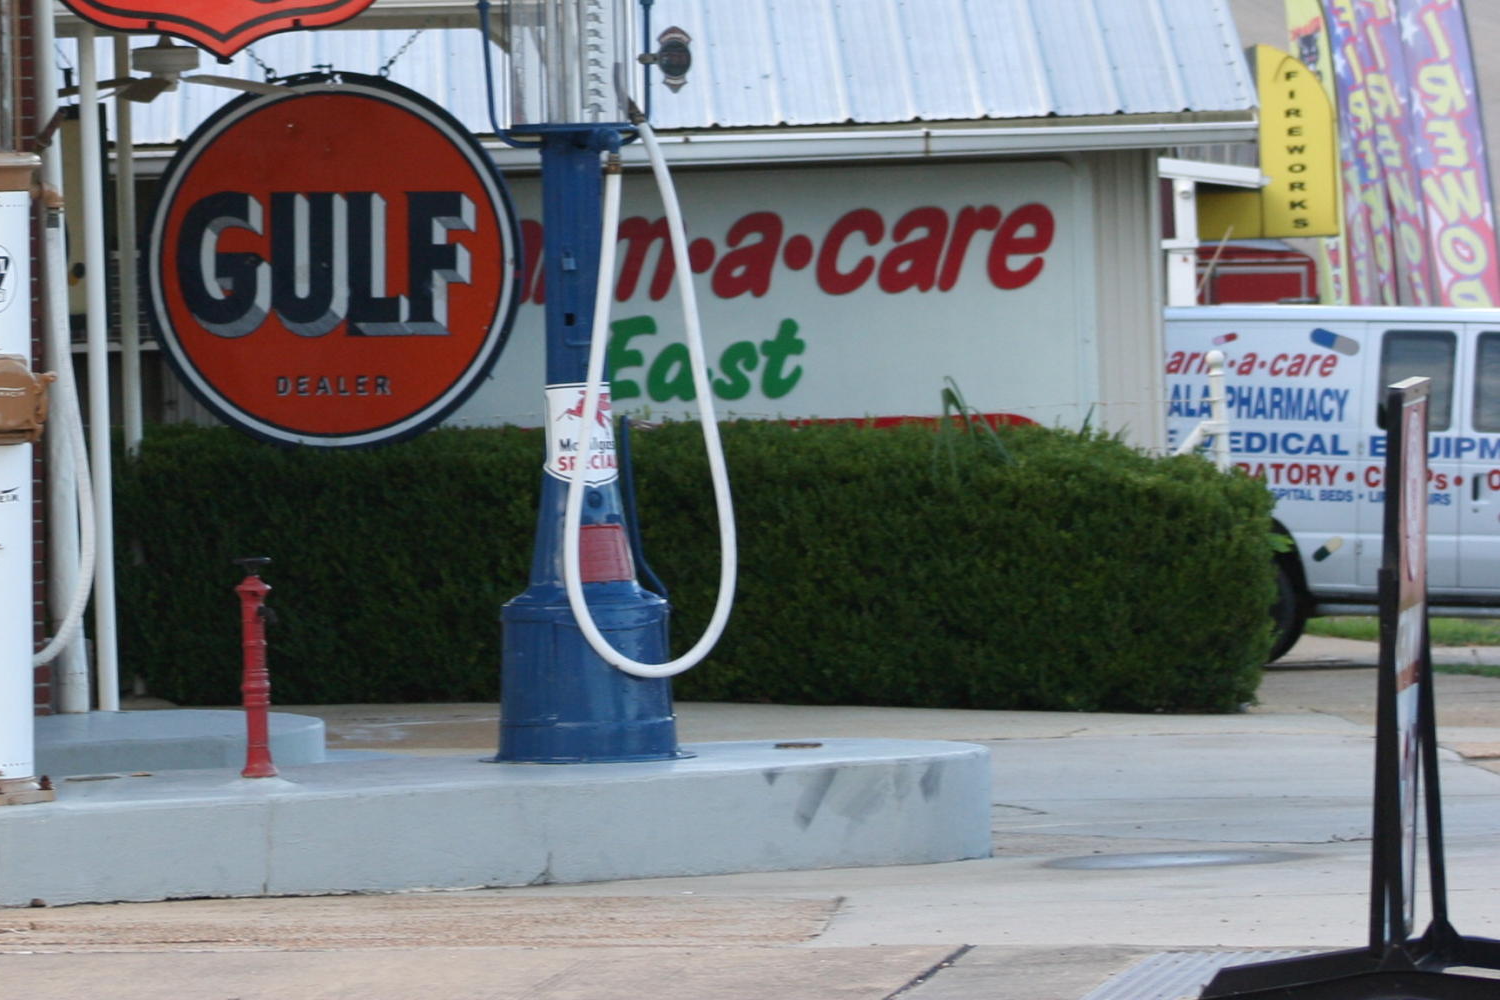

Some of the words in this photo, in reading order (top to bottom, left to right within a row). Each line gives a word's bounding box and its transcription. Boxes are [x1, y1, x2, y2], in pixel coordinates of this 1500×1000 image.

[1285, 71, 1309, 229] FIREWORKS
[177, 190, 476, 338] GULF
[608, 315, 805, 402] East
[276, 375, 391, 396] DEALER
[1225, 385, 1349, 422] PHARMACY
[1369, 435, 1500, 459] EUIPM
[558, 454, 618, 472] SPCIAL
[1319, 489, 1353, 502] BEDS
